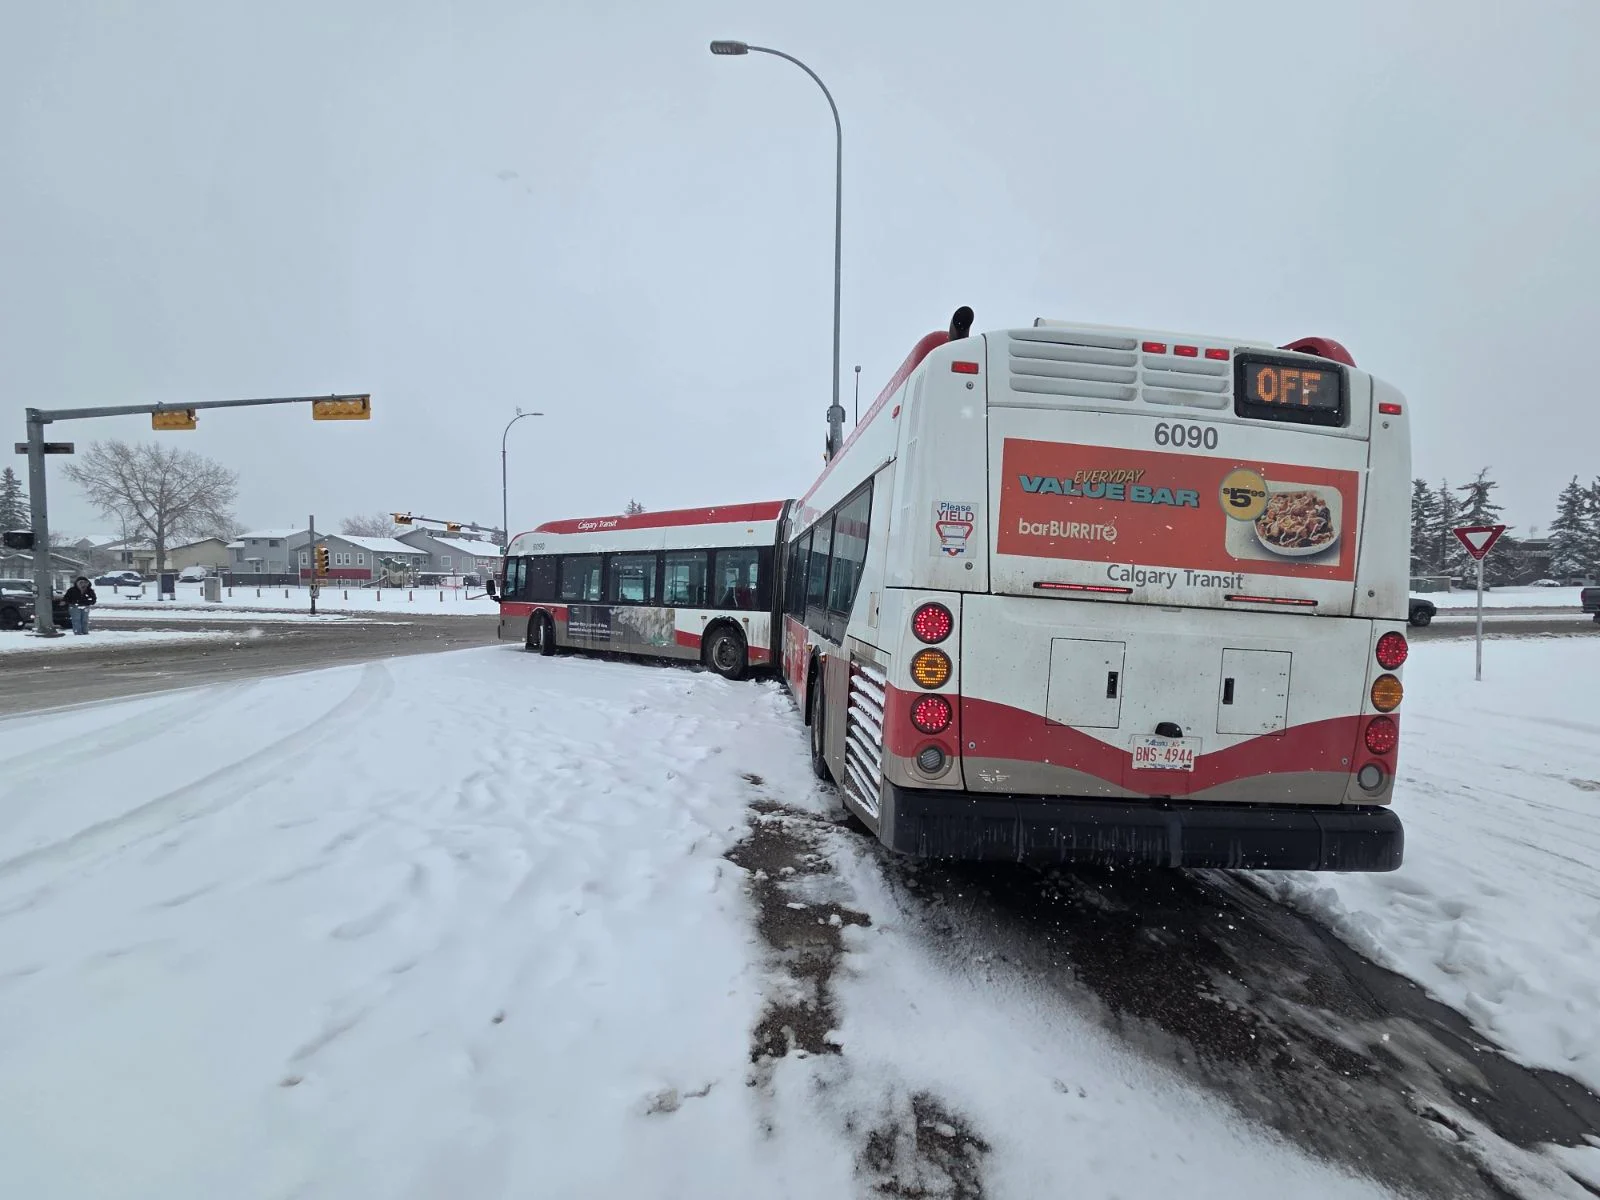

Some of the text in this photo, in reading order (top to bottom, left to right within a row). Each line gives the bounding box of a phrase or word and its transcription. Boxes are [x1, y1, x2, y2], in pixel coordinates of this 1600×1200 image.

[1256, 367, 1321, 406] OFF
[1154, 422, 1218, 450] 6090
[1074, 469, 1145, 484] EVERYDAY
[1019, 475, 1200, 508] VALUE BAR
[936, 510, 975, 522] YIELD
[940, 502, 972, 512] Please
[578, 519, 617, 530] Calgary Transit
[1106, 564, 1245, 590] Calgary Transit
[1135, 746, 1193, 764] BNS-4944
